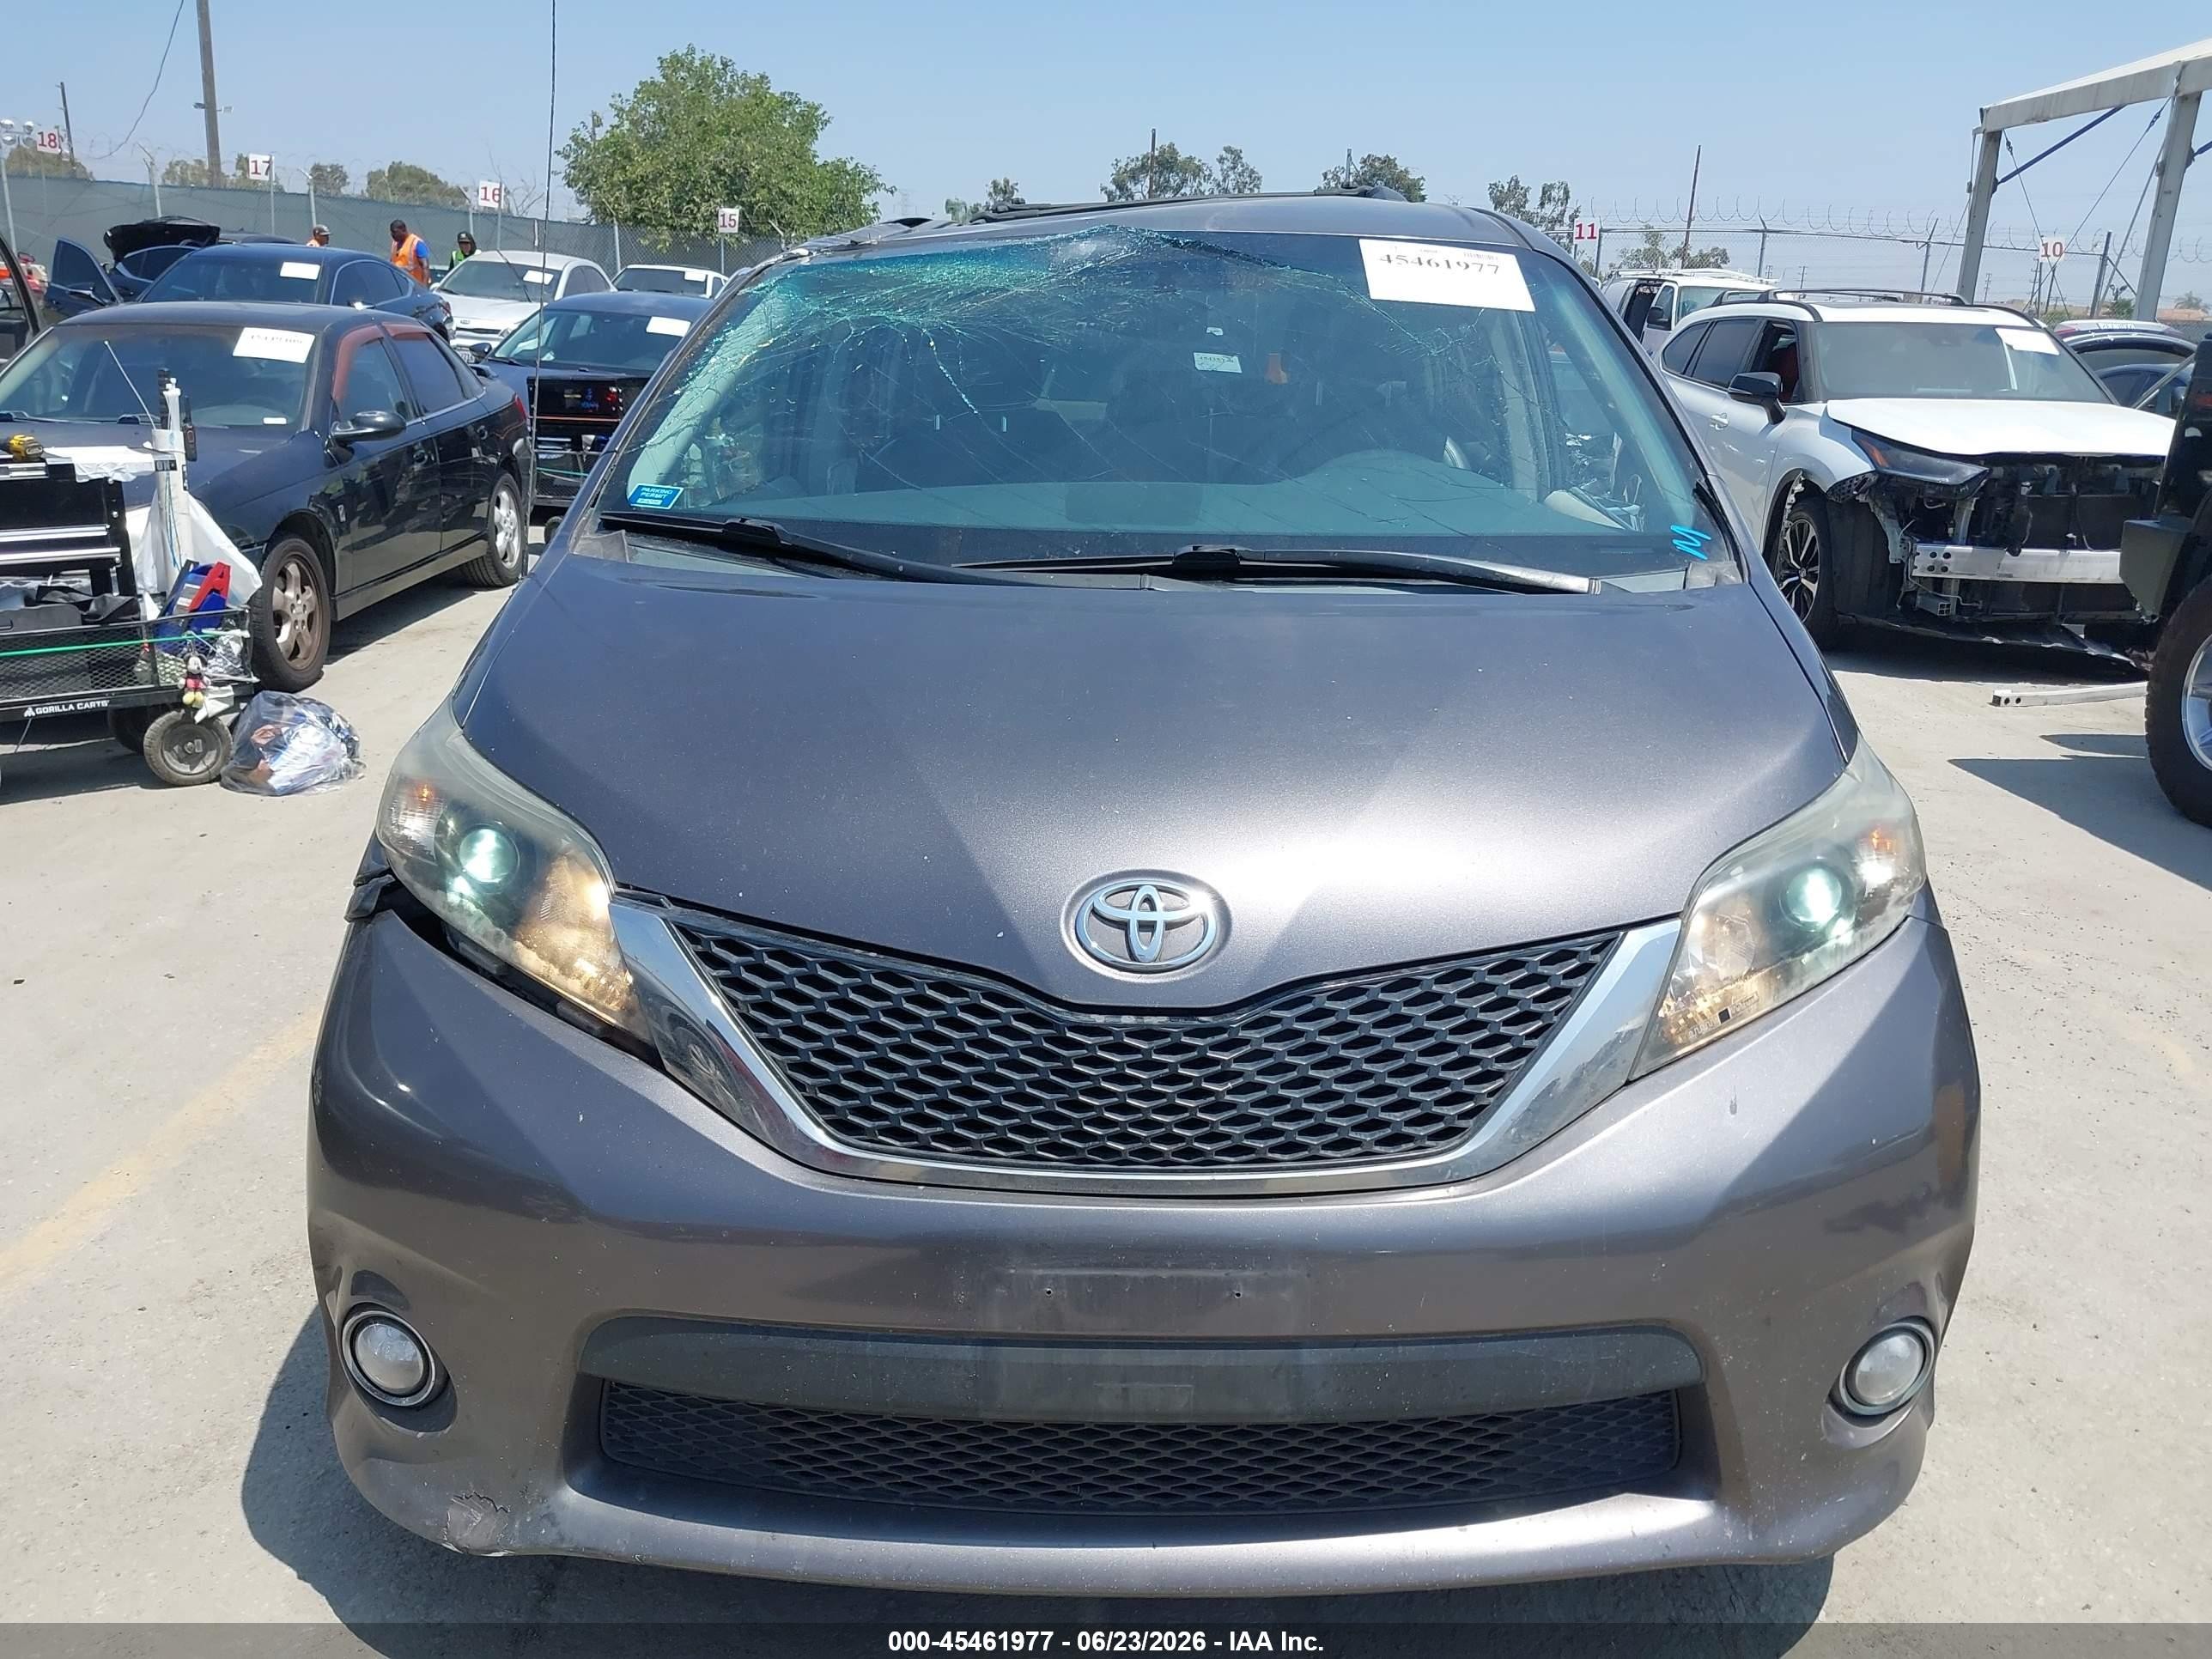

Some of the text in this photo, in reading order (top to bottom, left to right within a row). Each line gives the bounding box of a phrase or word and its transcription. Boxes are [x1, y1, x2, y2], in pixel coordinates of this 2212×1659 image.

[37, 131, 58, 149] 18
[251, 160, 271, 176] 17
[480, 185, 501, 204] 16
[720, 213, 737, 228] 15
[1574, 222, 1597, 240] 11
[2041, 241, 2063, 258] 10
[1379, 253, 1499, 275] 45461977
[35, 703, 75, 714] GORILLA
